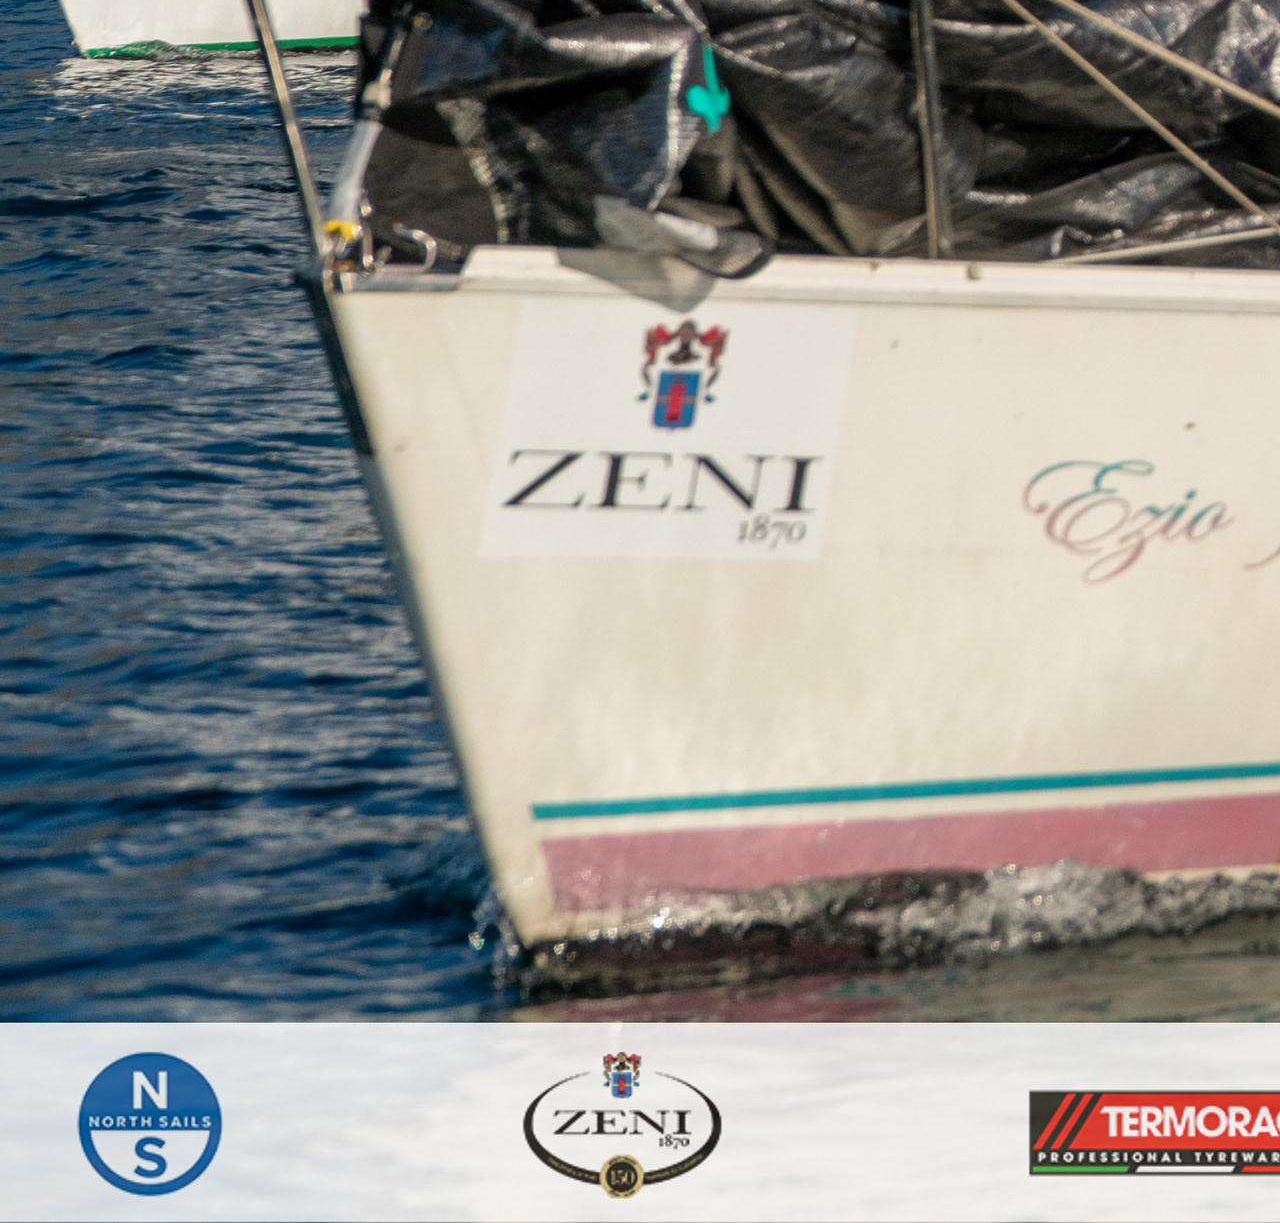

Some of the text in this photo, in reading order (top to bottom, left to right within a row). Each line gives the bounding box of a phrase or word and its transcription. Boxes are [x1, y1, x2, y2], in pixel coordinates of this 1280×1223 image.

[501, 449, 825, 513] ZENI
[737, 513, 808, 550] 1870
[1022, 459, 1234, 585] Ezio
